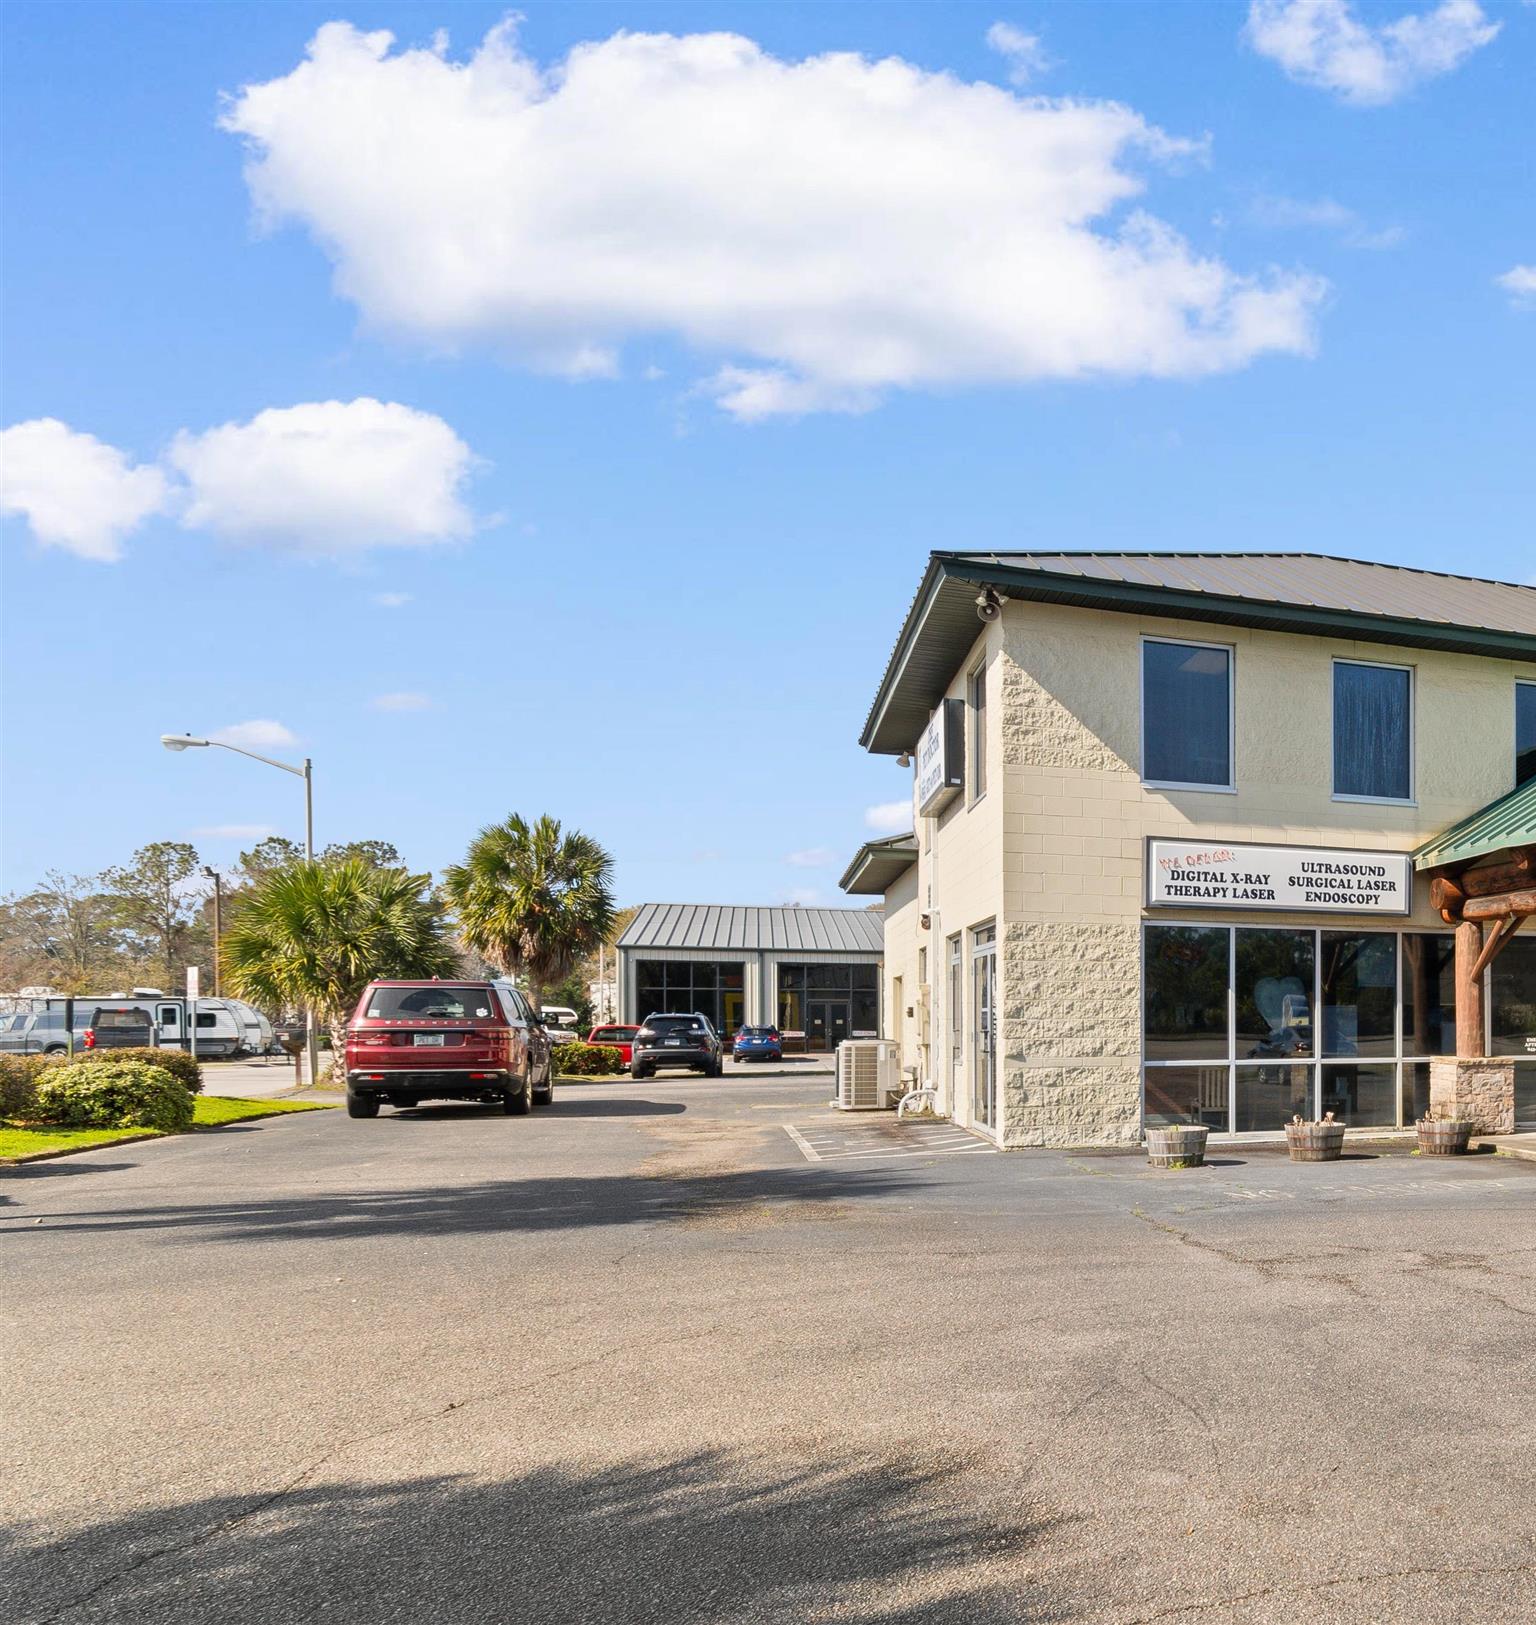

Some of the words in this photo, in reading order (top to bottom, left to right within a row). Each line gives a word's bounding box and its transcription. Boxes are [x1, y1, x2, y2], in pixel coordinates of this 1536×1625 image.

[1170, 869, 1226, 884] DIGITAL
[1230, 873, 1271, 886] X-RAY
[1300, 862, 1386, 877] ULTRASOUND
[1288, 875, 1354, 891] SURGICAL
[1357, 879, 1397, 892] LASER
[1165, 885, 1229, 899] THERAPY
[1232, 887, 1276, 901] LASER
[1304, 891, 1381, 905] ENDOSCOPY
